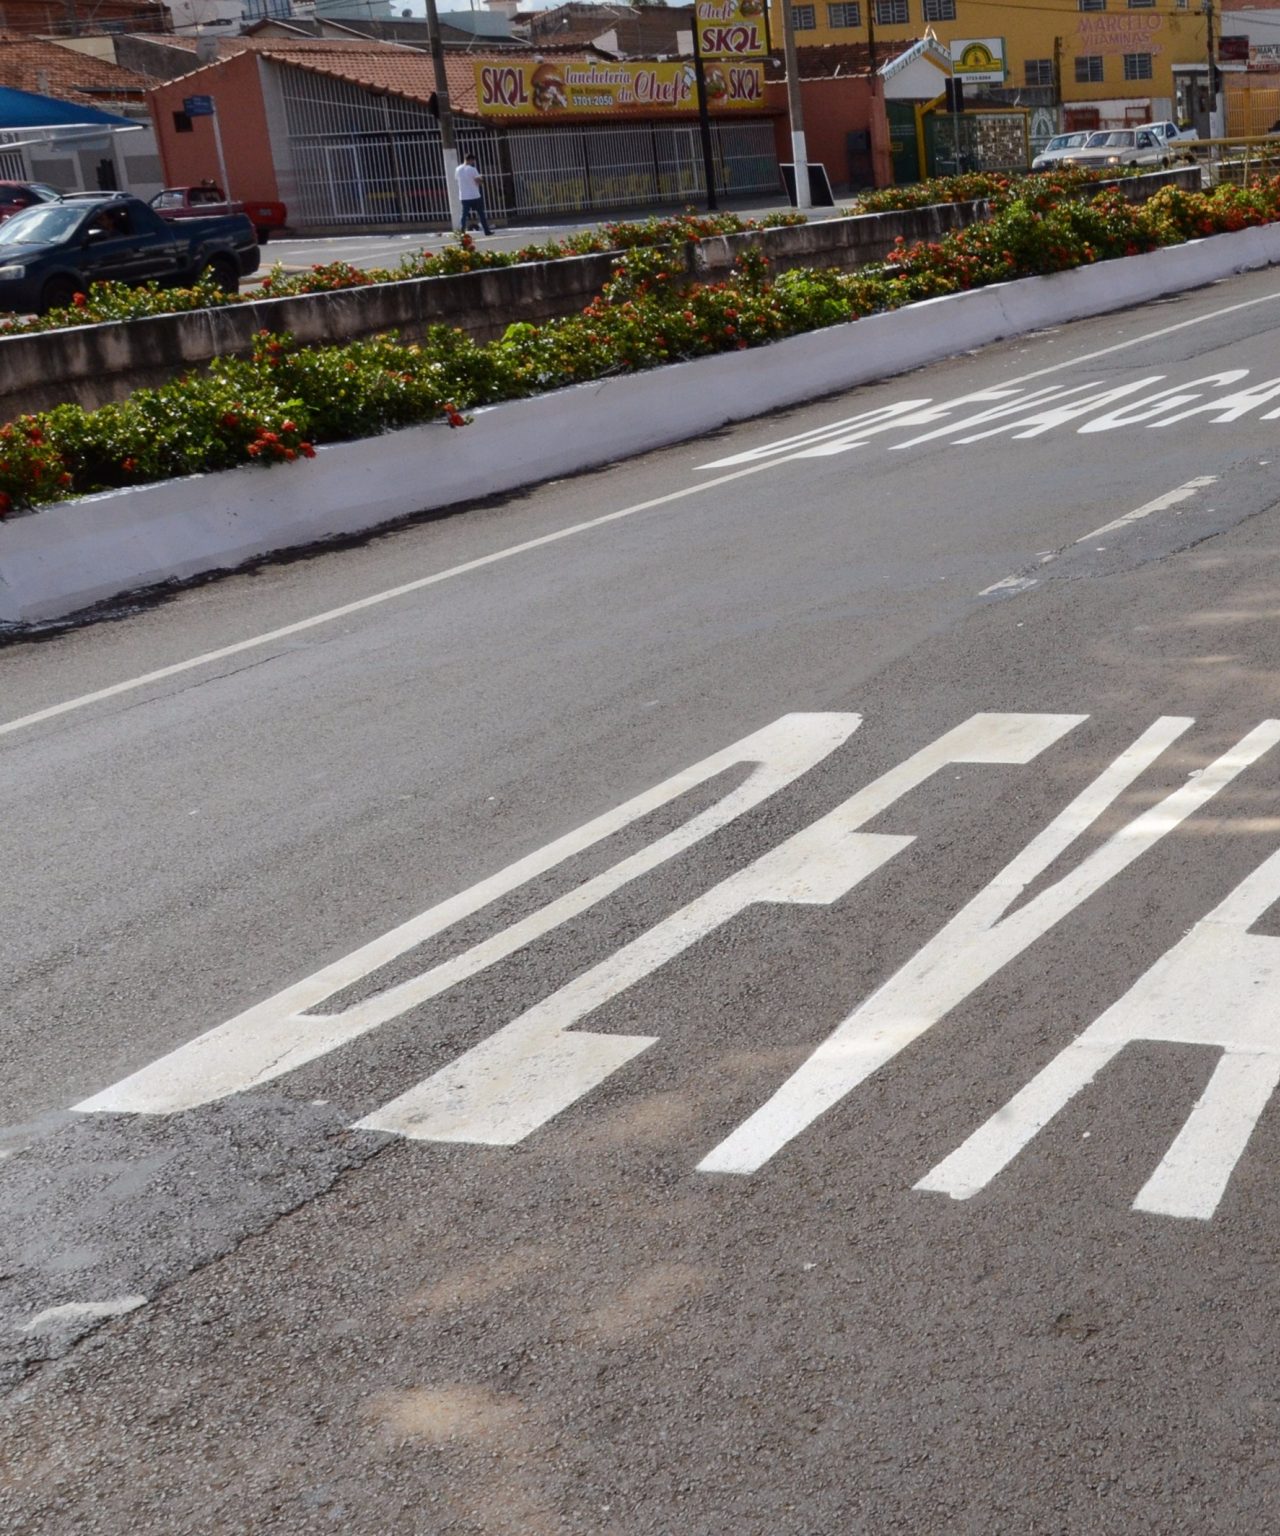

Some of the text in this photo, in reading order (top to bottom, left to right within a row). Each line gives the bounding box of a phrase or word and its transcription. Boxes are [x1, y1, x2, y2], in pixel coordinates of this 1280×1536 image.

[1077, 12, 1163, 32] MARCELO
[701, 26, 762, 53] SKOL
[481, 67, 529, 106] SKOL
[564, 65, 632, 85] lancheteria
[729, 67, 763, 101] SKOL
[573, 95, 613, 106] 3701-2050
[632, 70, 691, 109] Chefe
